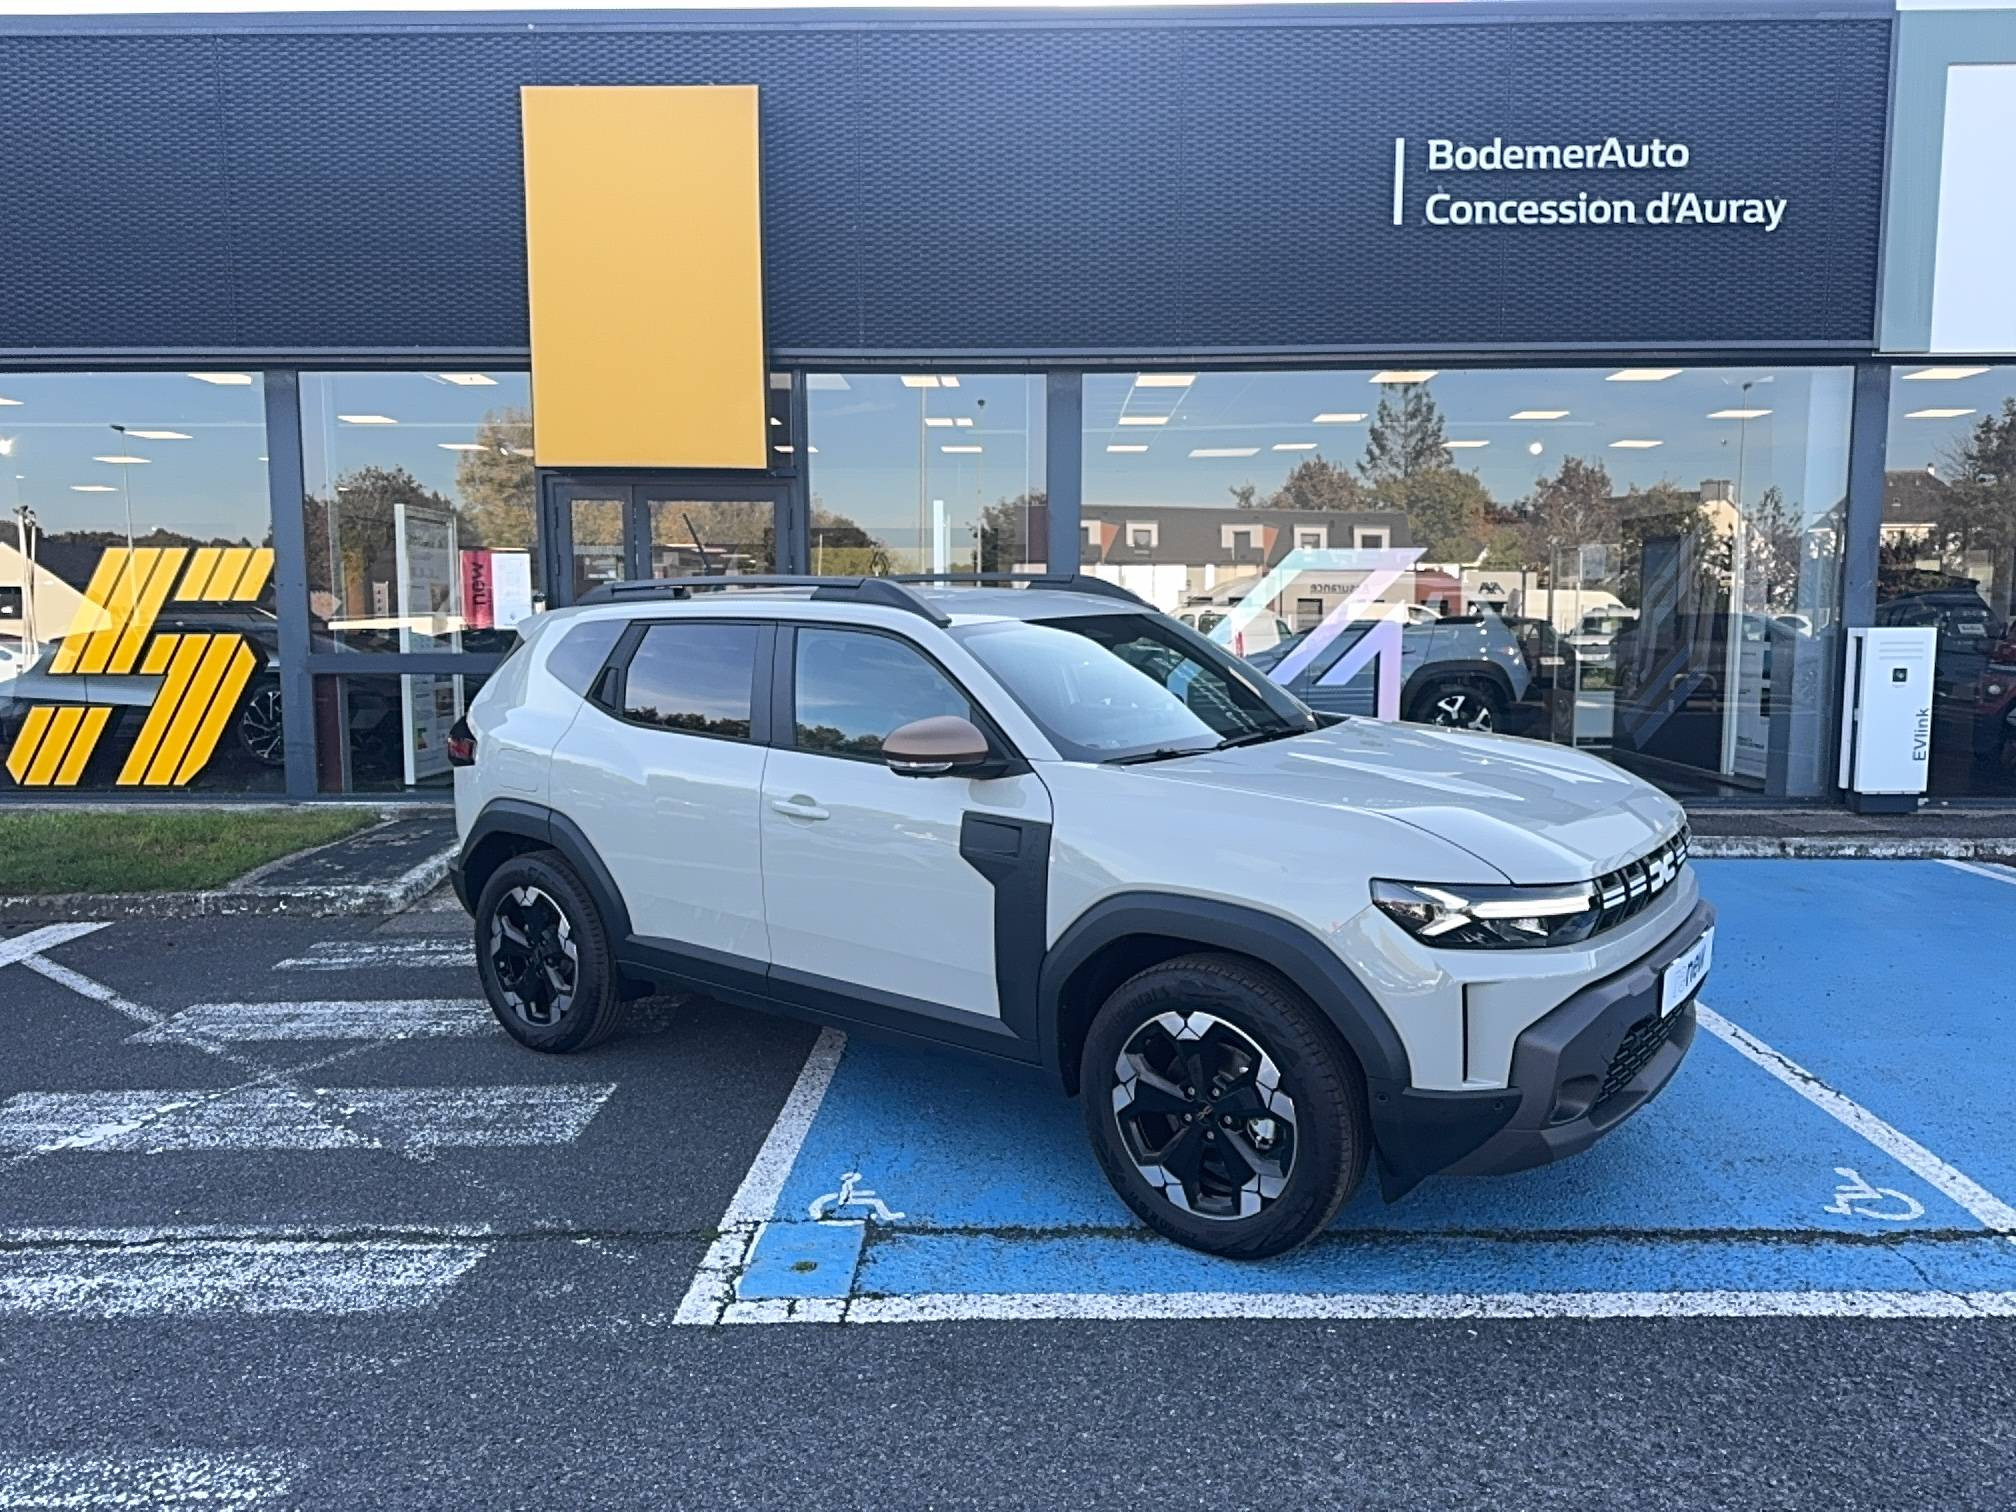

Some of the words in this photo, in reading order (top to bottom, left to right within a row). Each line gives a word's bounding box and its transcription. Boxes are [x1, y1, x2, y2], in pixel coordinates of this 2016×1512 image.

[1427, 137, 1690, 170] BodemerAuto
[1425, 191, 1637, 225] Concession
[1645, 191, 1788, 232] d'Auray
[1912, 708, 1929, 761] EVlink
